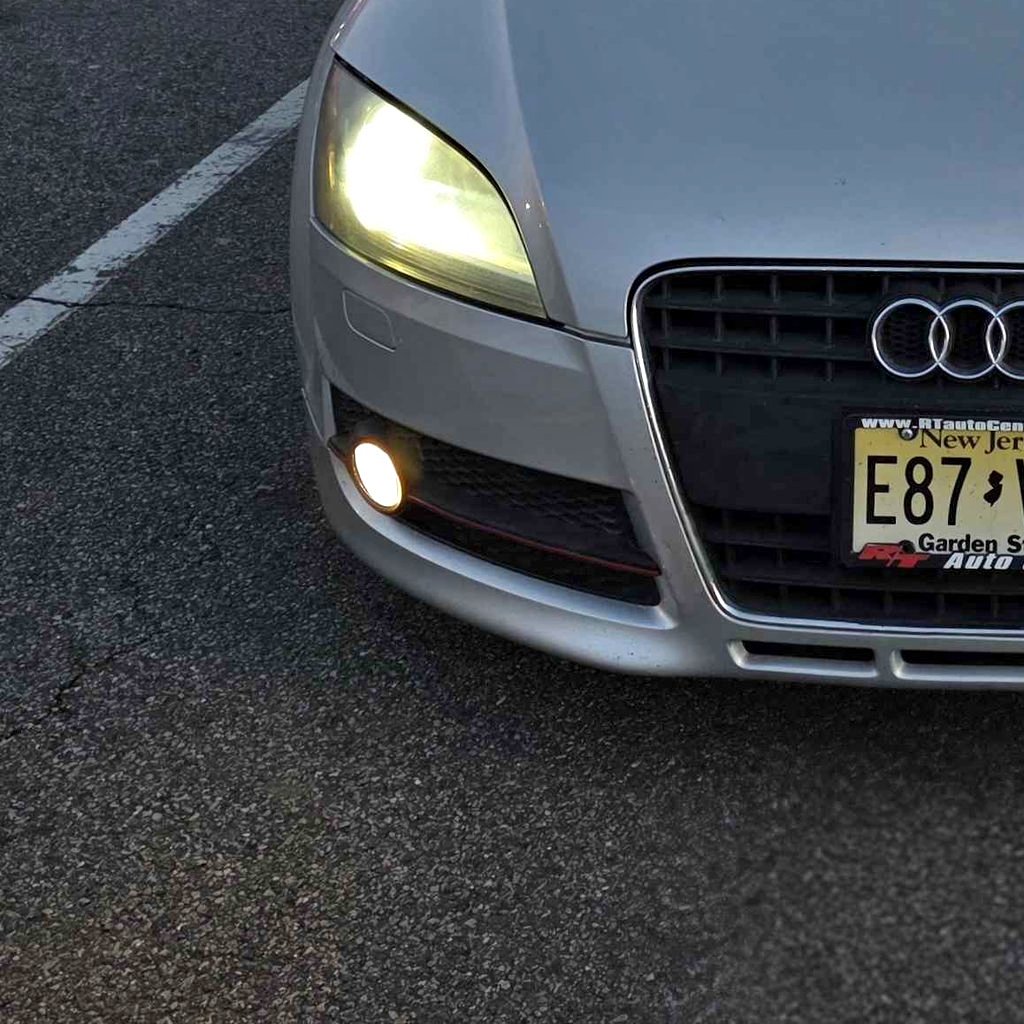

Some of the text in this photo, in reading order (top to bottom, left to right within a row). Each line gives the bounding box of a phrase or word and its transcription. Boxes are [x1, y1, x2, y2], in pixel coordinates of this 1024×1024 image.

[919, 430, 981, 449] New
[866, 455, 972, 526] E87
[918, 532, 998, 553] Garden
[943, 552, 1013, 570] Auto
